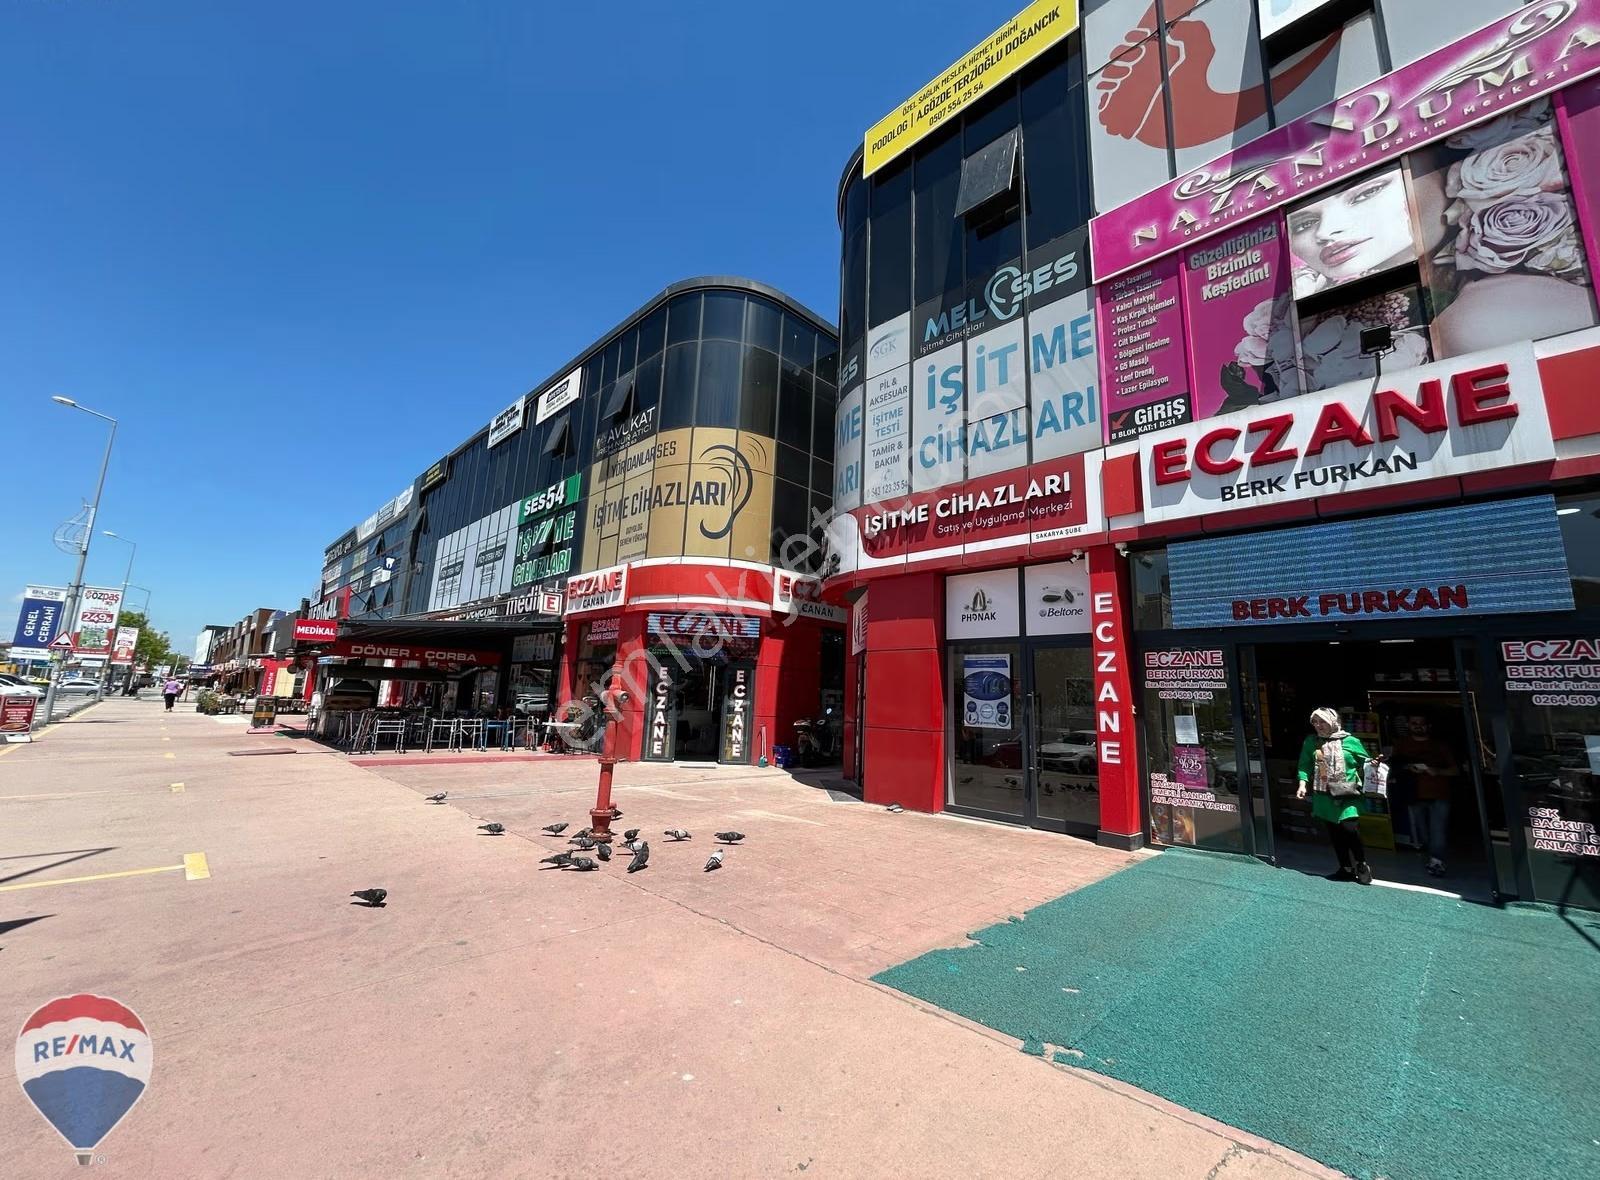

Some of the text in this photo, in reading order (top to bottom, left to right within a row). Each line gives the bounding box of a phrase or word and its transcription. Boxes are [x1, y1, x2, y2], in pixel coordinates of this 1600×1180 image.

[902, 21, 1019, 116] ÖZEL SAĞLIK MESLEK HİZMET BİRİMİ
[871, 6, 1061, 154] PODOLOG A.GÖZDE TERZİOĞLU DOĞANCIK
[928, 82, 984, 127] 0507 554 25 54
[1265, 189, 1285, 201] ve
[1462, 63, 1570, 116] Merkezi
[1133, 147, 1326, 249] NAZAN
[1189, 224, 1278, 270] Güzelliğinizi
[1208, 250, 1262, 281] Bizimle
[1202, 264, 1271, 301] Keşfedin!
[1133, 291, 1156, 305] Makyaj
[1117, 323, 1136, 336] Protez
[919, 336, 945, 355] İşitme
[926, 313, 1096, 415] İŞİTME
[1120, 365, 1155, 383] Lenf Drenaj
[879, 376, 898, 392] PİL &
[1121, 375, 1169, 395] Lazer Epilasyon
[868, 385, 908, 408] AKSESUAR
[872, 406, 904, 429] İŞİTME
[919, 386, 1097, 469] CİHAZLARI
[1118, 427, 1137, 439] BLOK
[1138, 423, 1158, 435] KAT:1
[1160, 417, 1177, 428] D:31
[1153, 362, 1519, 487] ECZANE
[875, 420, 901, 439] TESTİ
[871, 440, 904, 459] TAMİR &
[874, 454, 900, 470] BAKIM
[1220, 451, 1419, 503] BERK FURKAN
[523, 480, 566, 517] SES54
[630, 480, 727, 517] CİHAZLARI
[864, 471, 1072, 536] İŞİTME CİHAZLARI
[937, 500, 1074, 536] Satış ve Uygulama Merkezi
[1035, 526, 1083, 540] SAKARYA ŞUBE
[568, 570, 624, 600] ECZANE
[546, 596, 557, 610] E
[582, 596, 605, 609] CANAN
[801, 604, 835, 618] CANAN
[1047, 607, 1084, 618] Beltone
[1231, 583, 1470, 621] BERK FURKAN
[24, 609, 39, 637] GENEL
[37, 605, 56, 643] CERRAHİ
[659, 614, 746, 636] ECZANE
[961, 611, 997, 623] PHONAK
[296, 624, 336, 636] MEDİKAL
[350, 643, 411, 658] DÖNER
[1144, 650, 1224, 667] ECZANE
[1094, 591, 1121, 765] ECZANE
[1146, 669, 1225, 680] BERK FURKAN
[1506, 665, 1564, 678] BERK
[1532, 681, 1560, 691] Berk
[653, 665, 669, 755] ECZANE
[1532, 694, 1598, 706] 0264 503
[731, 669, 747, 758] ECZANE
[1528, 806, 1560, 819] SSK
